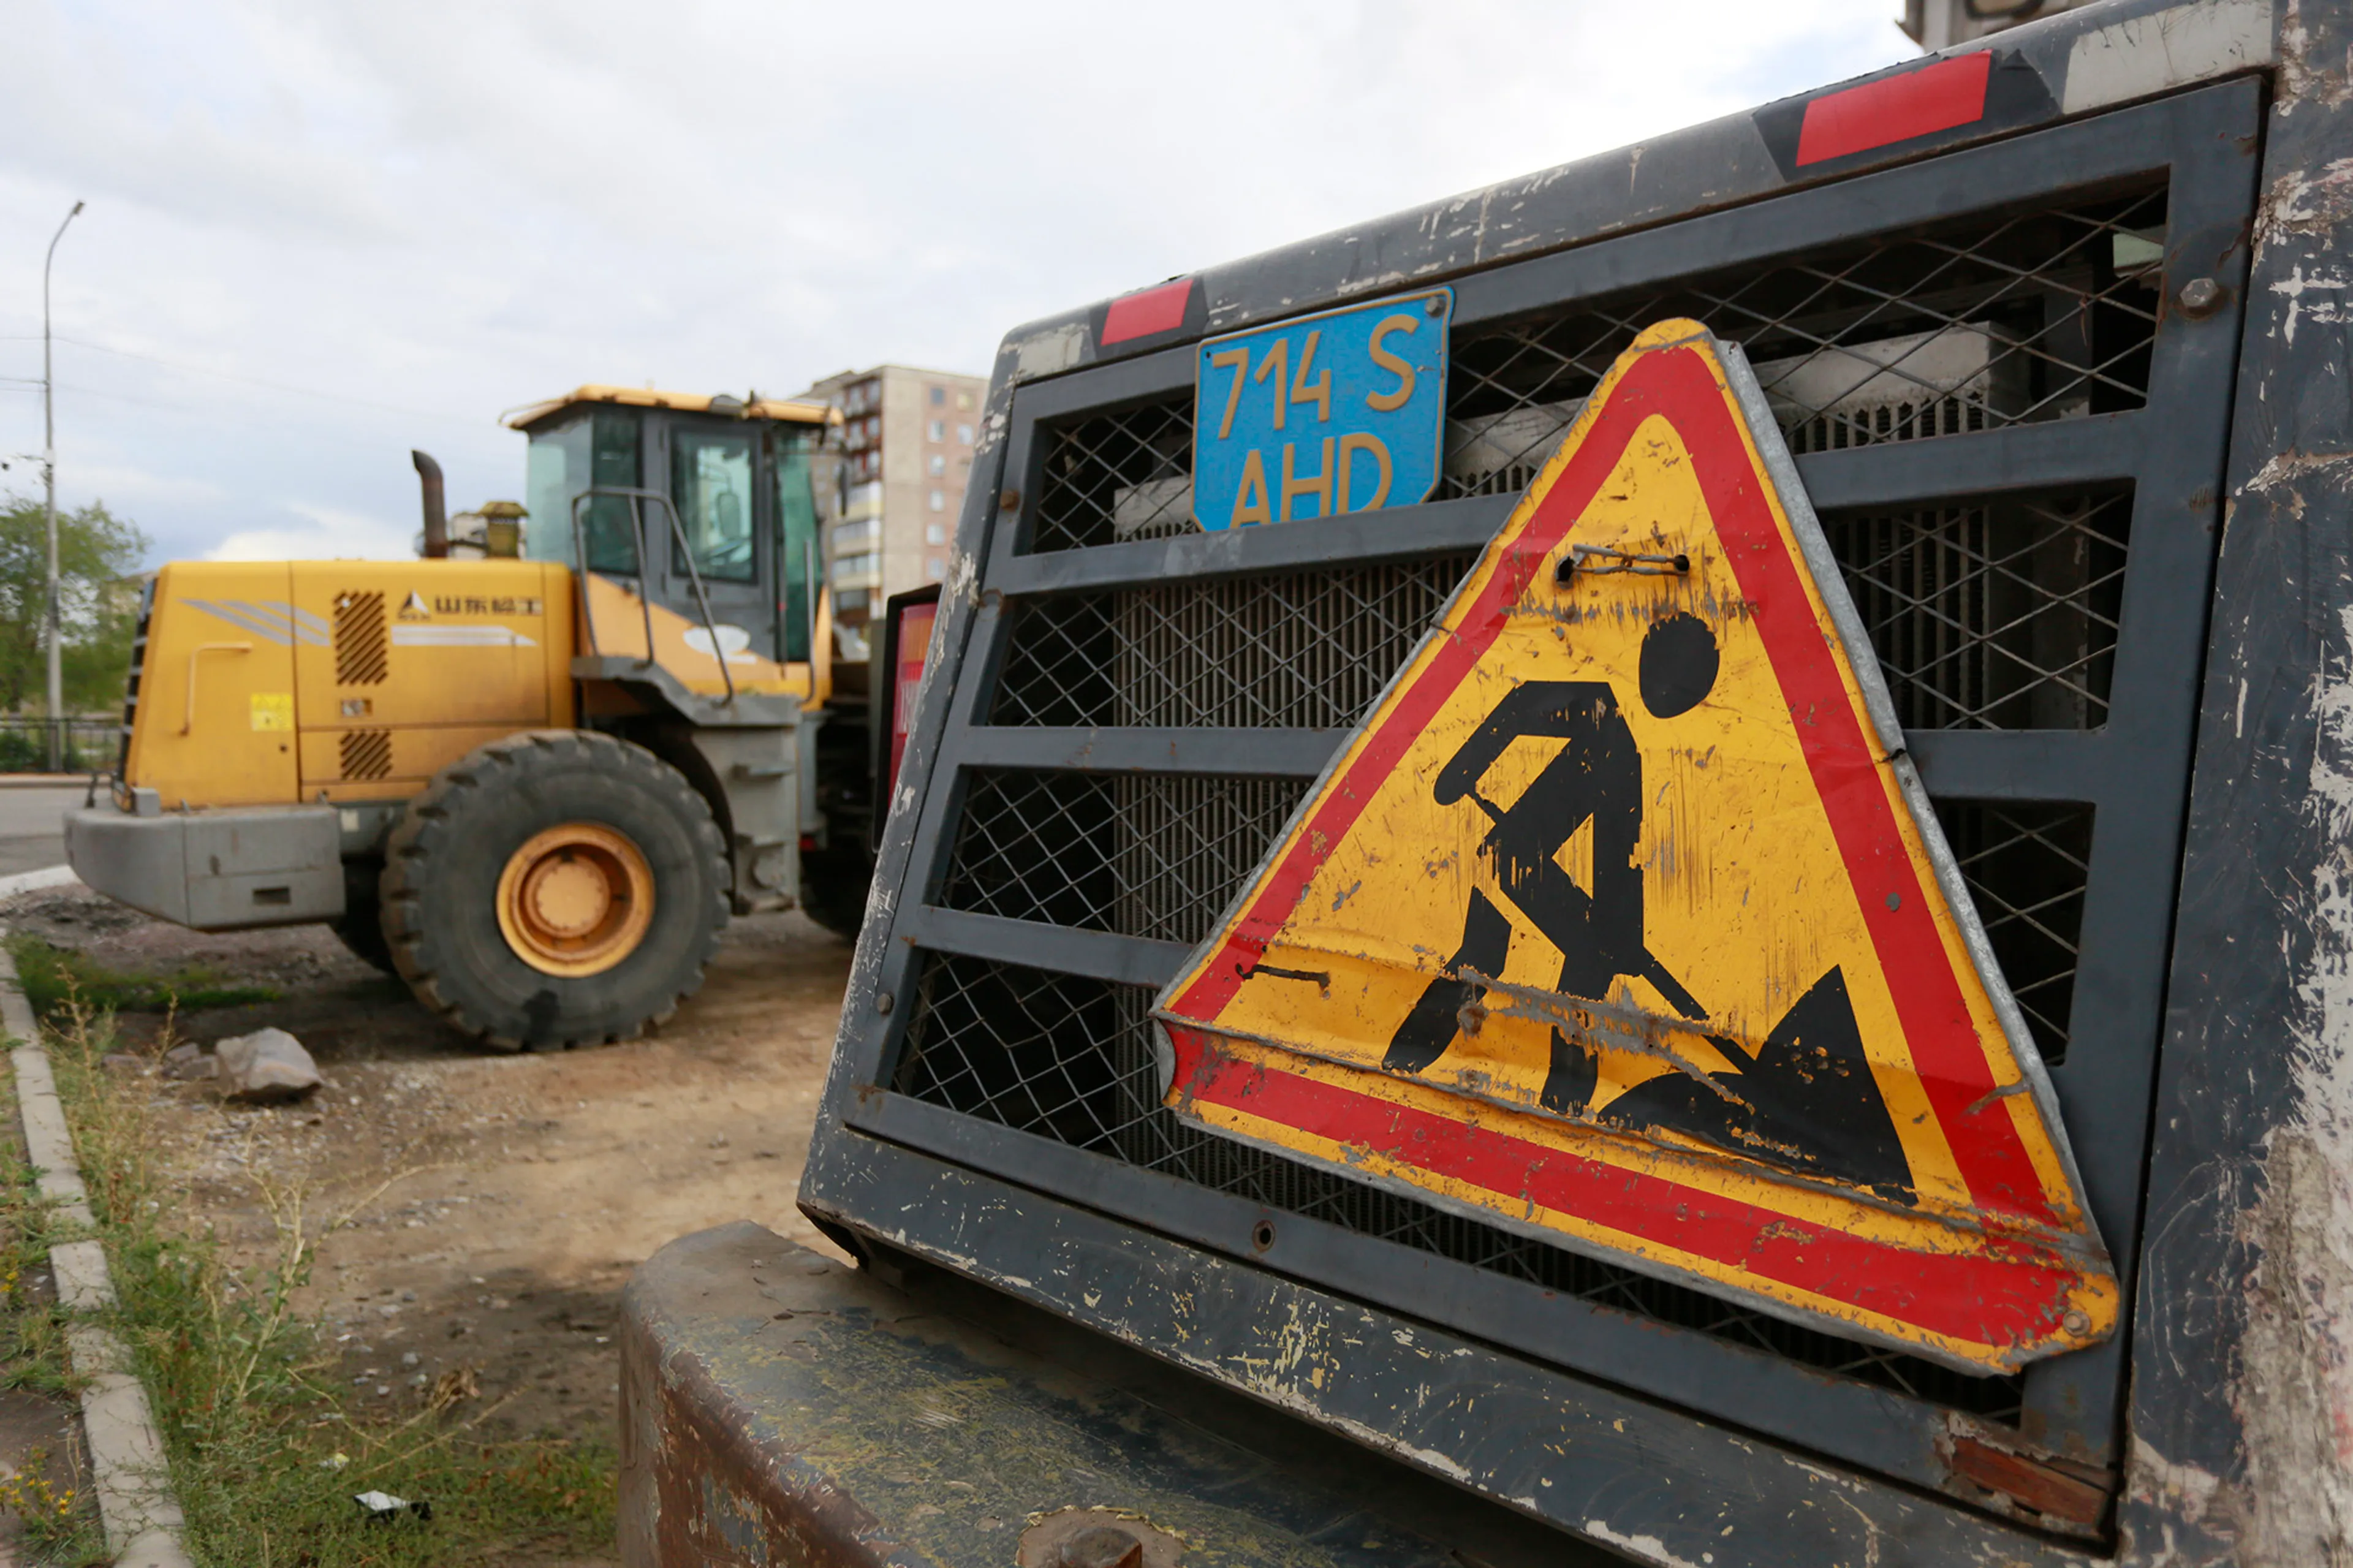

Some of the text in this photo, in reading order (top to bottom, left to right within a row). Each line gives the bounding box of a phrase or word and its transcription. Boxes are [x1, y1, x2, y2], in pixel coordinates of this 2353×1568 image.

[1211, 314, 1420, 440] 714 S
[1229, 431, 1393, 529] AHD
